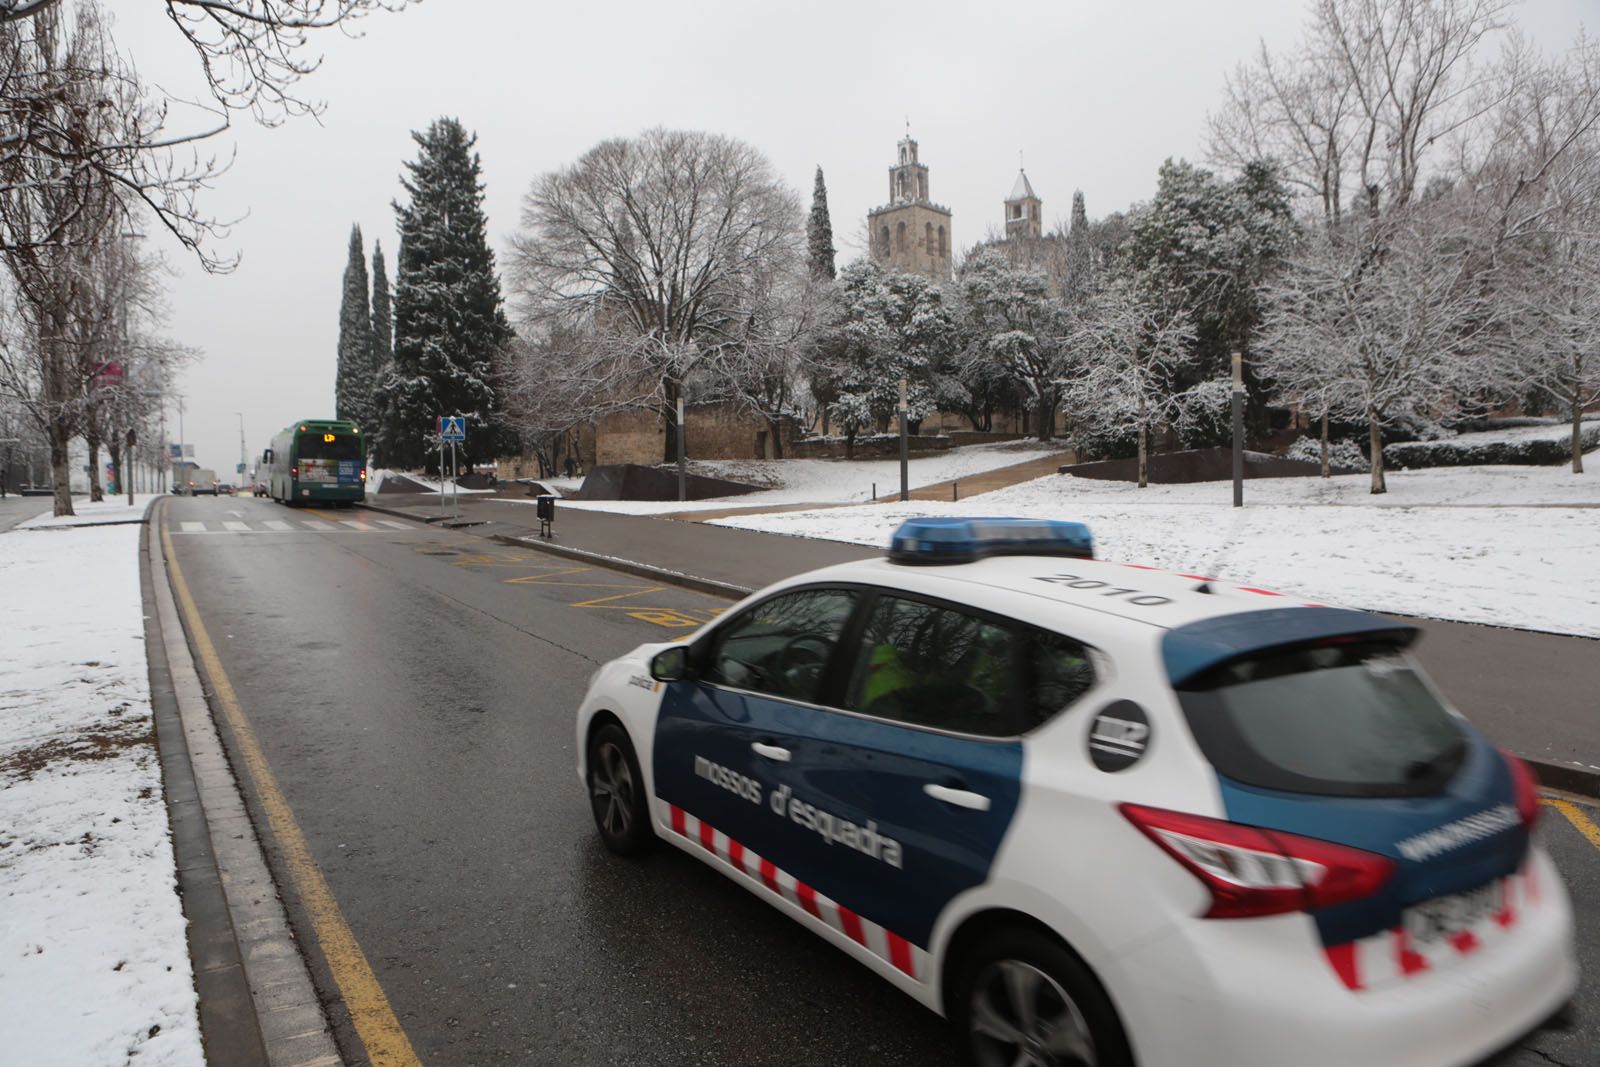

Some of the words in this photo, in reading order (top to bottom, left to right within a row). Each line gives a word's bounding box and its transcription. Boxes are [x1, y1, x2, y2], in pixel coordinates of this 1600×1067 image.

[1033, 574, 1173, 606] 2010
[695, 755, 762, 805] mossos
[769, 783, 904, 870] d'esquadra
